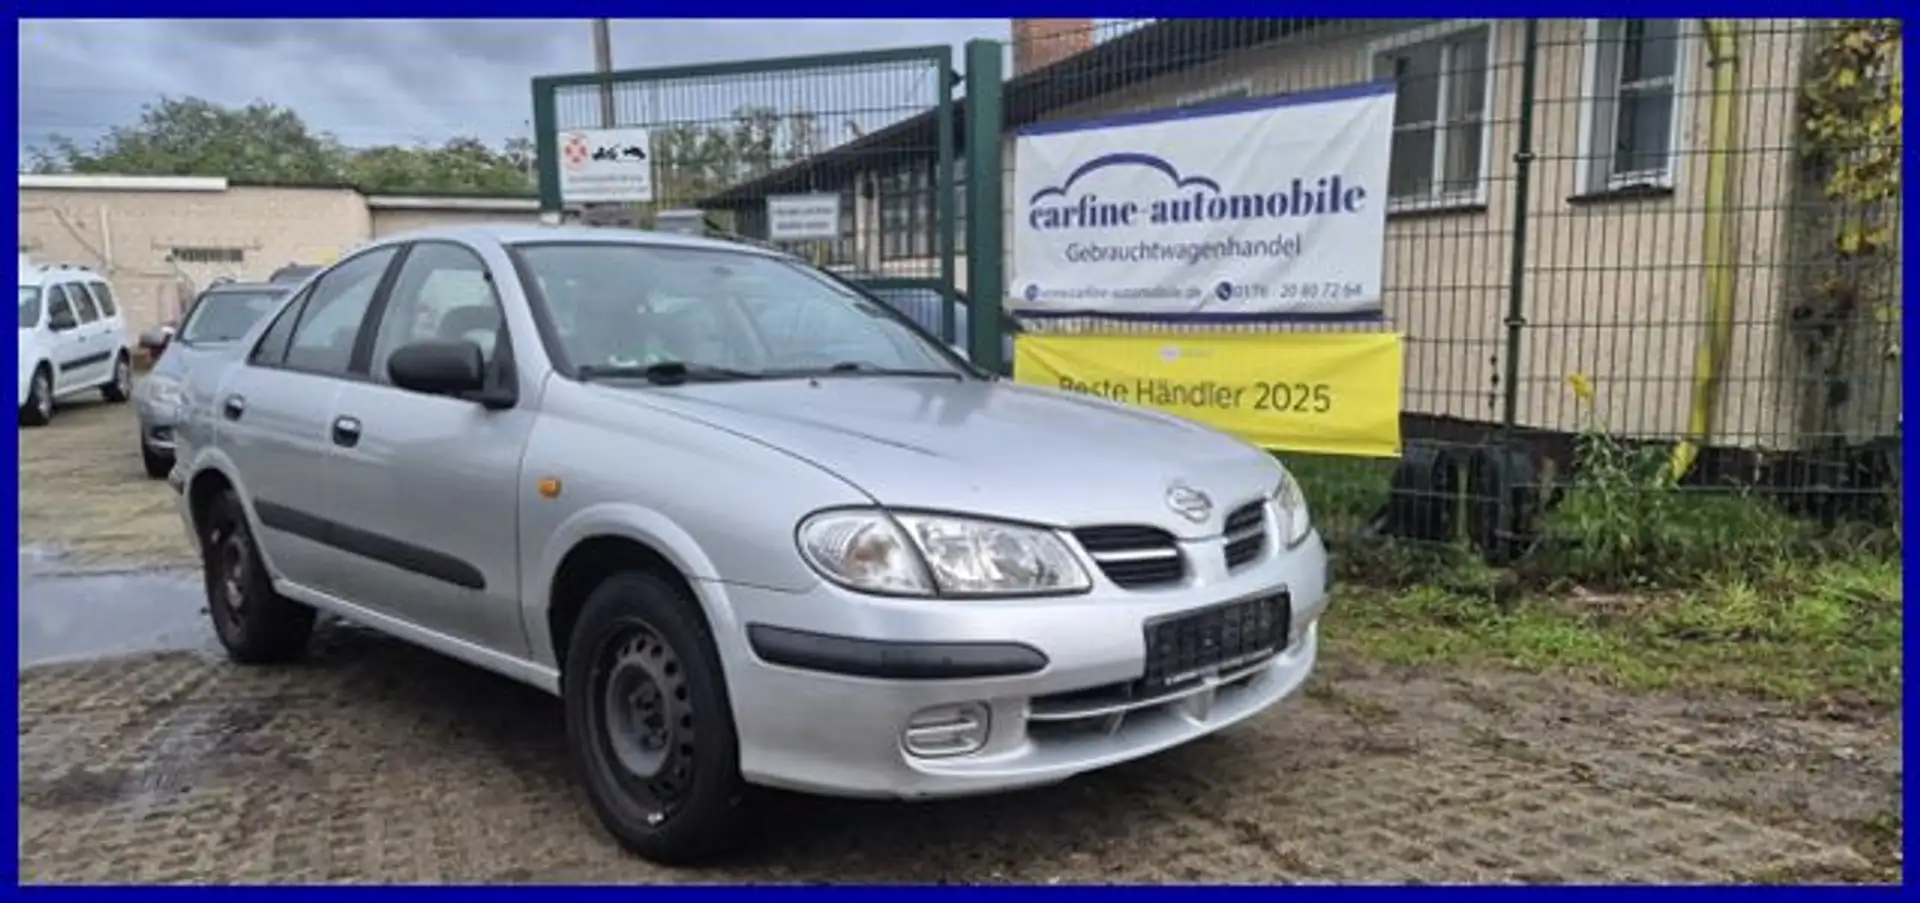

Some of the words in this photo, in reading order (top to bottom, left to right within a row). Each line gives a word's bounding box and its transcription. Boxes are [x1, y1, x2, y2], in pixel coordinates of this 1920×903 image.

[1029, 175, 1366, 230] carfine-automobile
[1065, 233, 1301, 264] Gebrauchtwagenhandel
[1136, 377, 1247, 409] Händler
[1254, 380, 1332, 413] 2025
